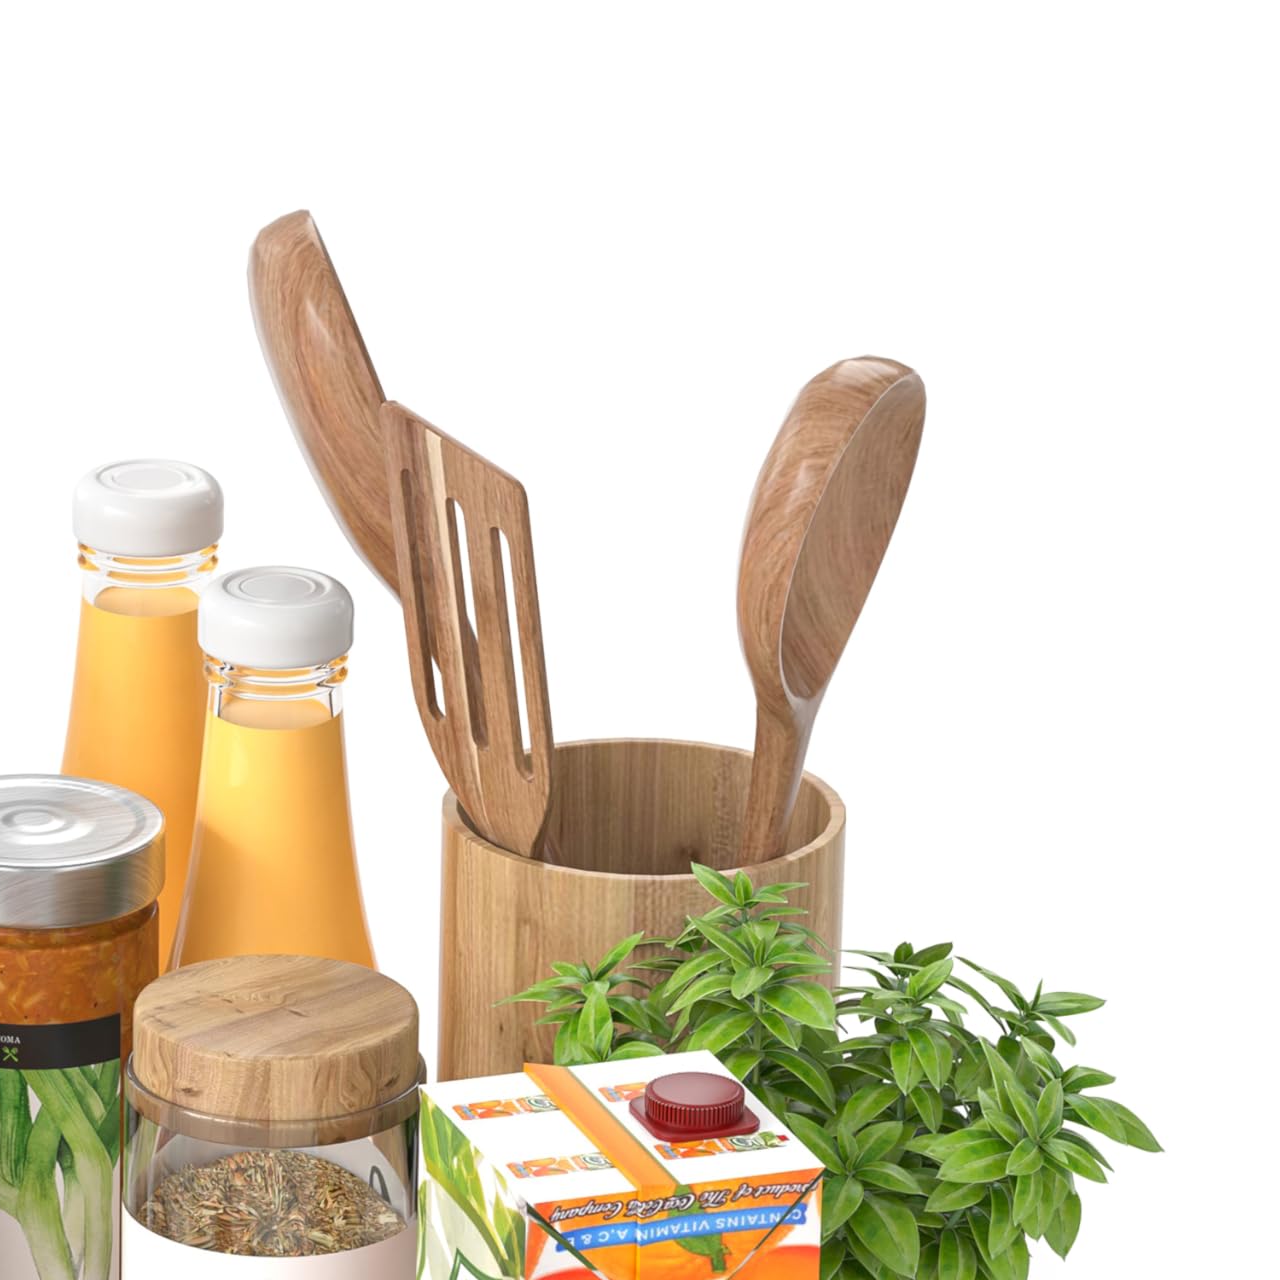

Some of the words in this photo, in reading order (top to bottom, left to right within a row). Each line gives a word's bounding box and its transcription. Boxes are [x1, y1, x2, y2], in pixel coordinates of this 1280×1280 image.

[698, 1187, 731, 1208] The
[549, 1200, 622, 1223] Company
[716, 1208, 803, 1230] CNTAINS
[581, 1233, 592, 1245] &
[637, 1217, 711, 1243] VITAMIN
